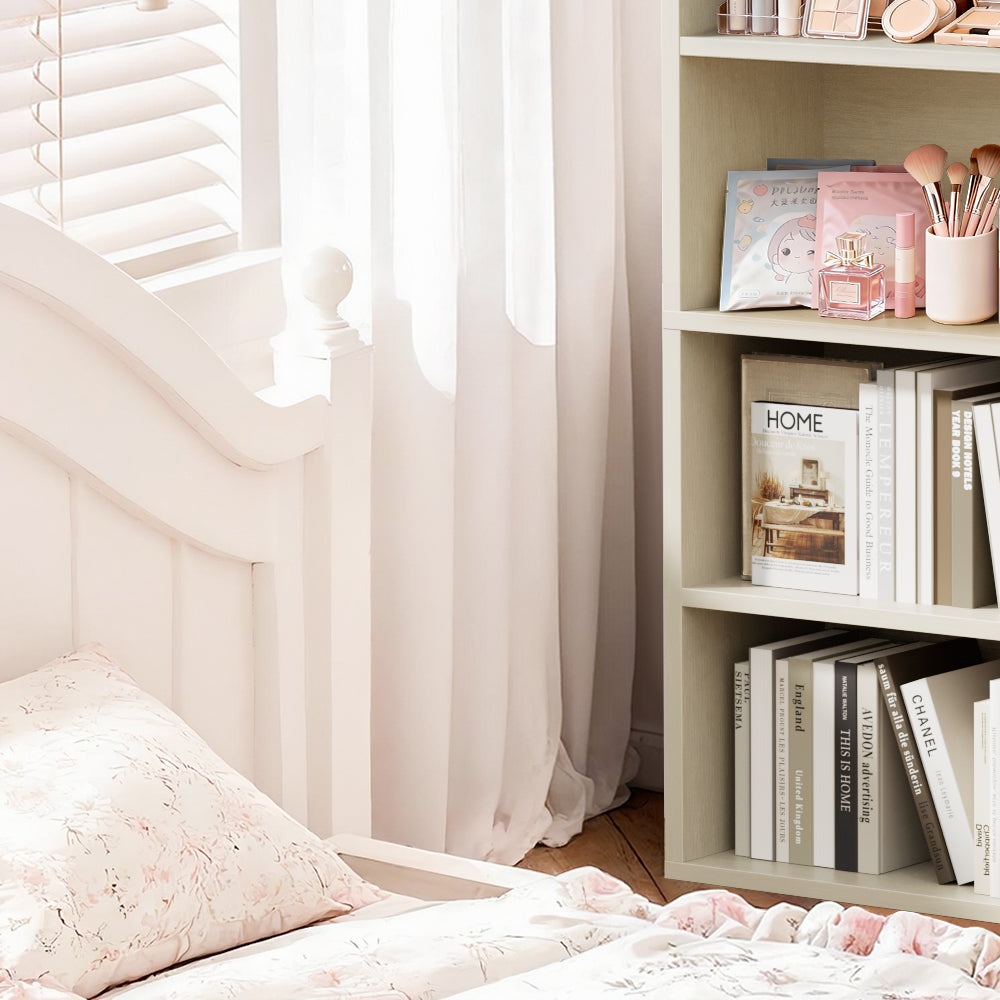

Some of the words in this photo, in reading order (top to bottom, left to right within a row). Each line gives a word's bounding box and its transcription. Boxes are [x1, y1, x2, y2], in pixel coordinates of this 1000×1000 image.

[767, 409, 824, 433] HOME
[865, 405, 874, 424] The
[951, 409, 961, 437] YEAR
[963, 410, 973, 450] DESIGN
[864, 426, 874, 467] Monocle
[951, 439, 961, 468] BOOK
[865, 469, 874, 499] Guide
[952, 470, 961, 478] 9
[963, 451, 973, 491] HOTELS
[865, 501, 873, 510] to
[865, 512, 874, 538] Good
[864, 540, 874, 581] Business
[878, 663, 891, 691] saum
[735, 670, 743, 730] SIETSEMA
[793, 684, 805, 733] England
[886, 692, 897, 708] für
[861, 707, 873, 759] AVEDON
[891, 709, 903, 730] alla
[911, 694, 938, 758] CHANEL
[840, 728, 851, 757] THIS
[898, 731, 909, 749] die
[840, 760, 851, 772] IS
[903, 749, 922, 796] sünderin
[795, 769, 803, 802] United
[840, 774, 851, 813] HOME
[859, 762, 874, 824] advertising
[793, 804, 804, 845] Kingdom
